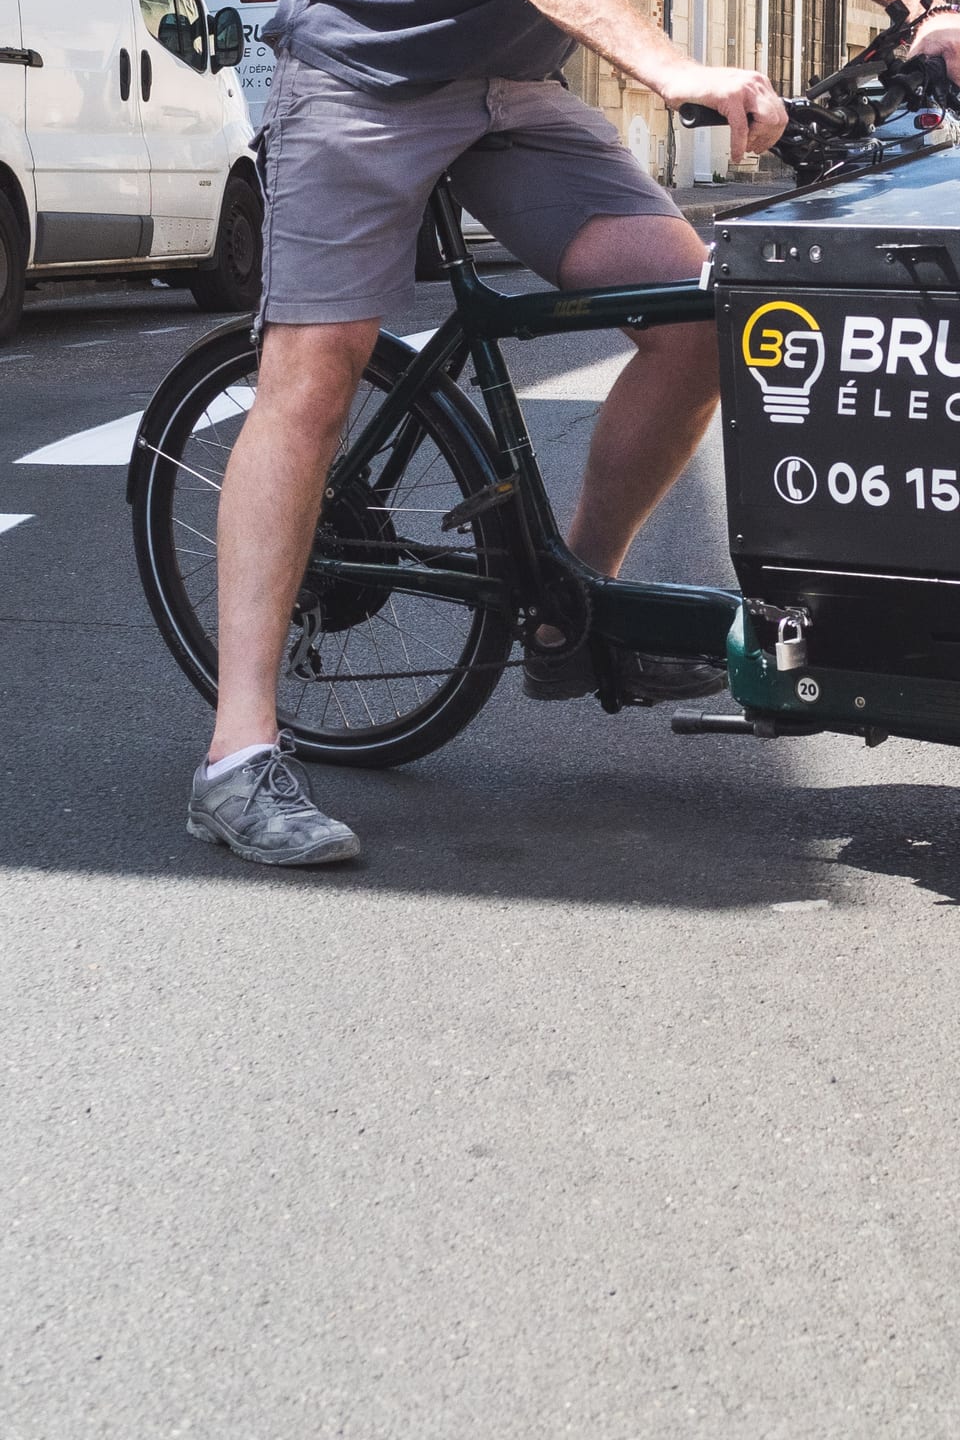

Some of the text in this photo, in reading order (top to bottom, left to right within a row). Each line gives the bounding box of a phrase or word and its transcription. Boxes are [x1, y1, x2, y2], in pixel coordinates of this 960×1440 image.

[828, 462, 890, 507] 06
[906, 468, 960, 512] 15
[800, 682, 816, 696] 20
